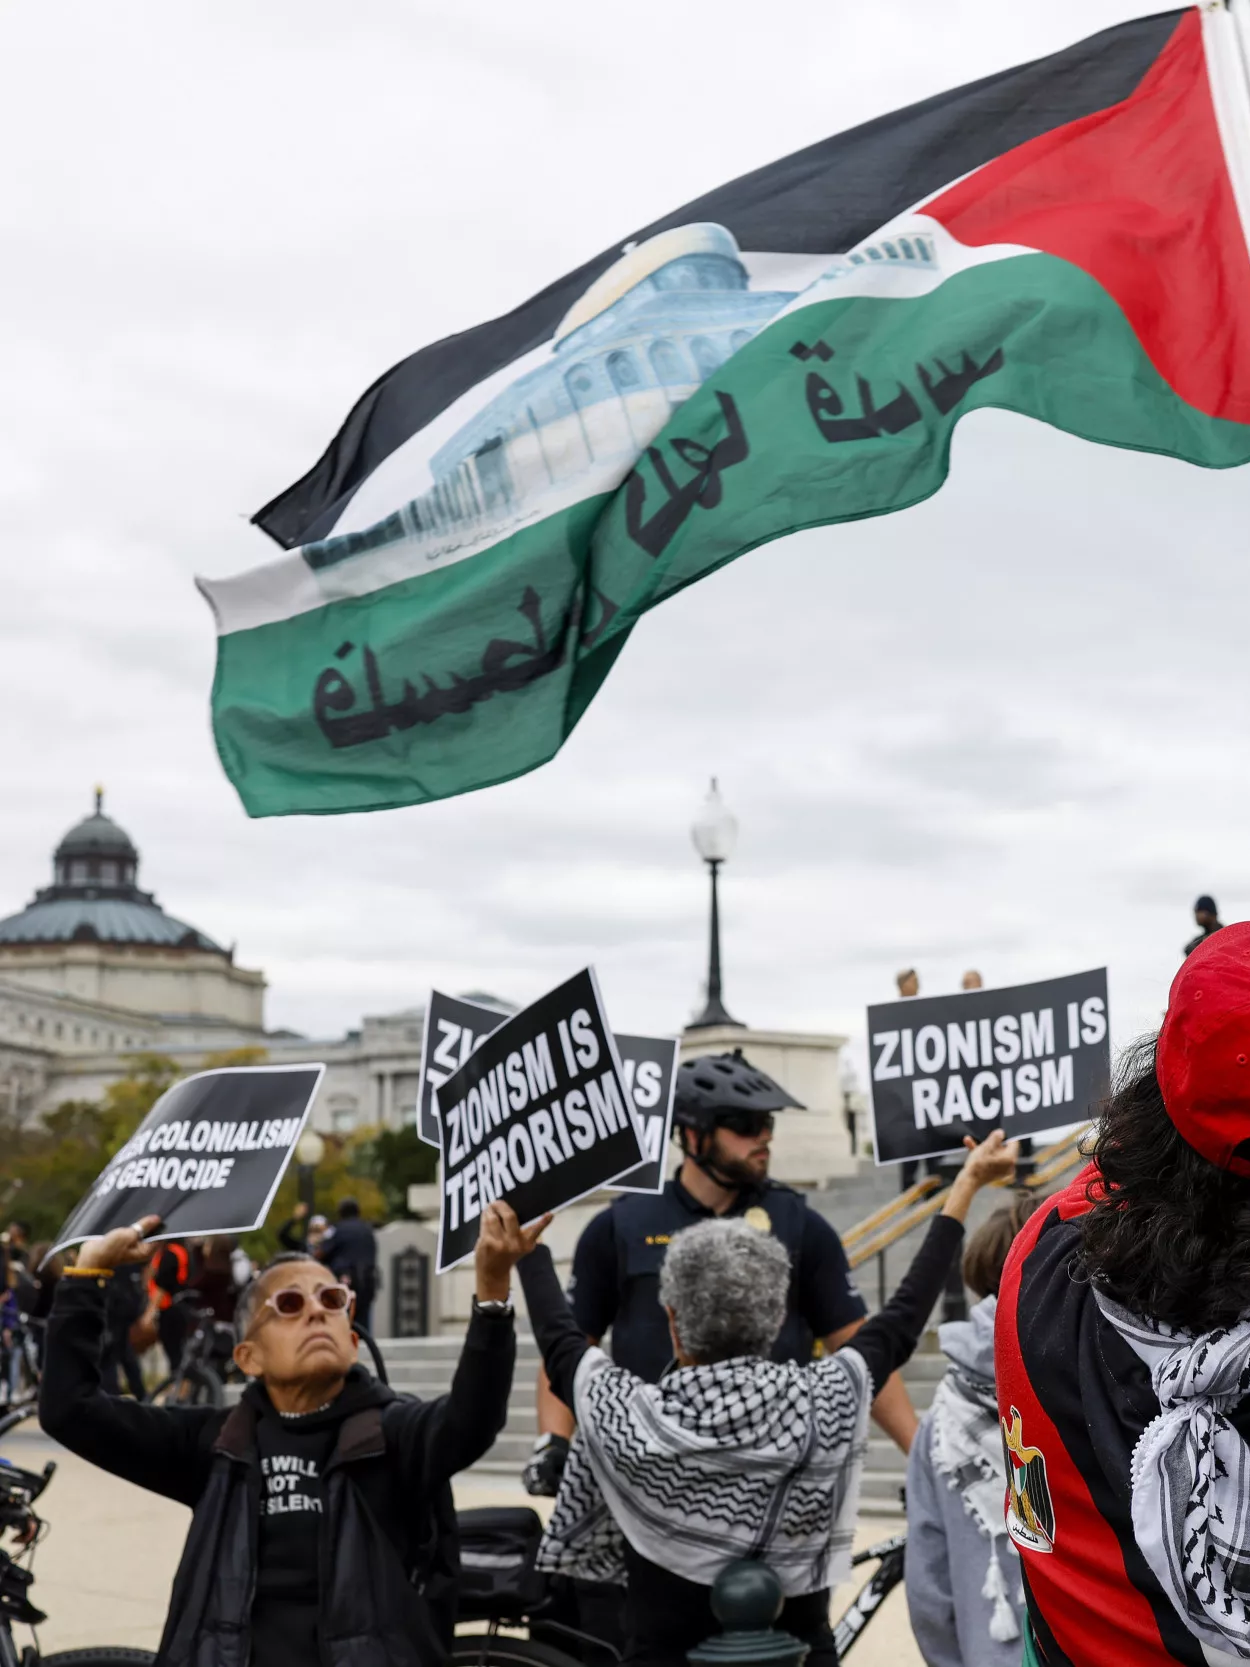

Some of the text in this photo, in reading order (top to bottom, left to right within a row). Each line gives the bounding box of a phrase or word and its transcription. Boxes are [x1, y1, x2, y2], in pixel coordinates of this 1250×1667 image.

[873, 996, 1108, 1082] ZIONISM IS
[445, 1032, 558, 1168] ZIONISM
[557, 1008, 600, 1079] IS
[911, 1054, 1075, 1130] RACISM
[149, 1117, 301, 1153] COLONIALISM
[445, 1070, 629, 1232] TERRORISM
[115, 1157, 236, 1191] GENOCIDE
[271, 1455, 319, 1478] WILL
[1012, 1523, 1039, 1544] فلسطين
